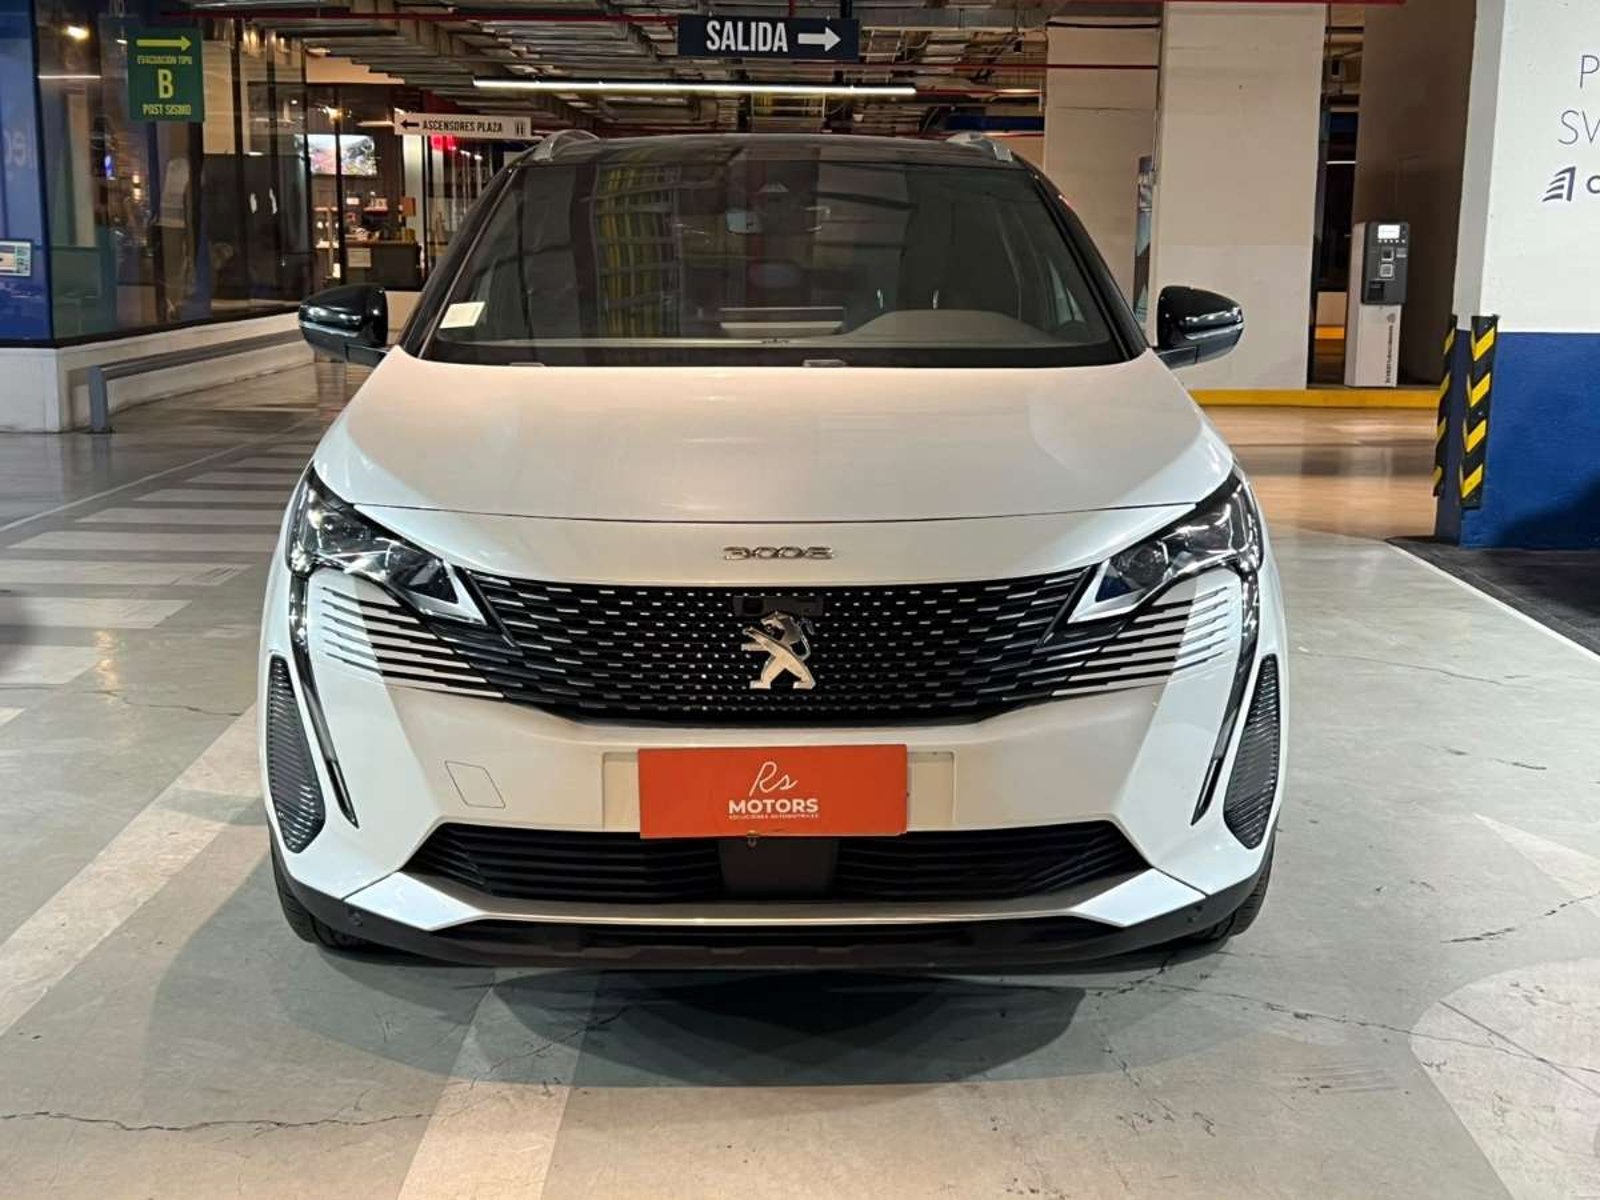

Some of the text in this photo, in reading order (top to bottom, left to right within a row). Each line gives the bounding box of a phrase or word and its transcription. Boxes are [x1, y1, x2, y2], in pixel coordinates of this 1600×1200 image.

[706, 20, 789, 52] SALIDA
[158, 68, 174, 98] B
[142, 103, 191, 116] POST SISMO
[423, 120, 502, 133] ASCENSORES PLAZA
[748, 761, 799, 797] Rs
[728, 798, 819, 814] MOTORS
